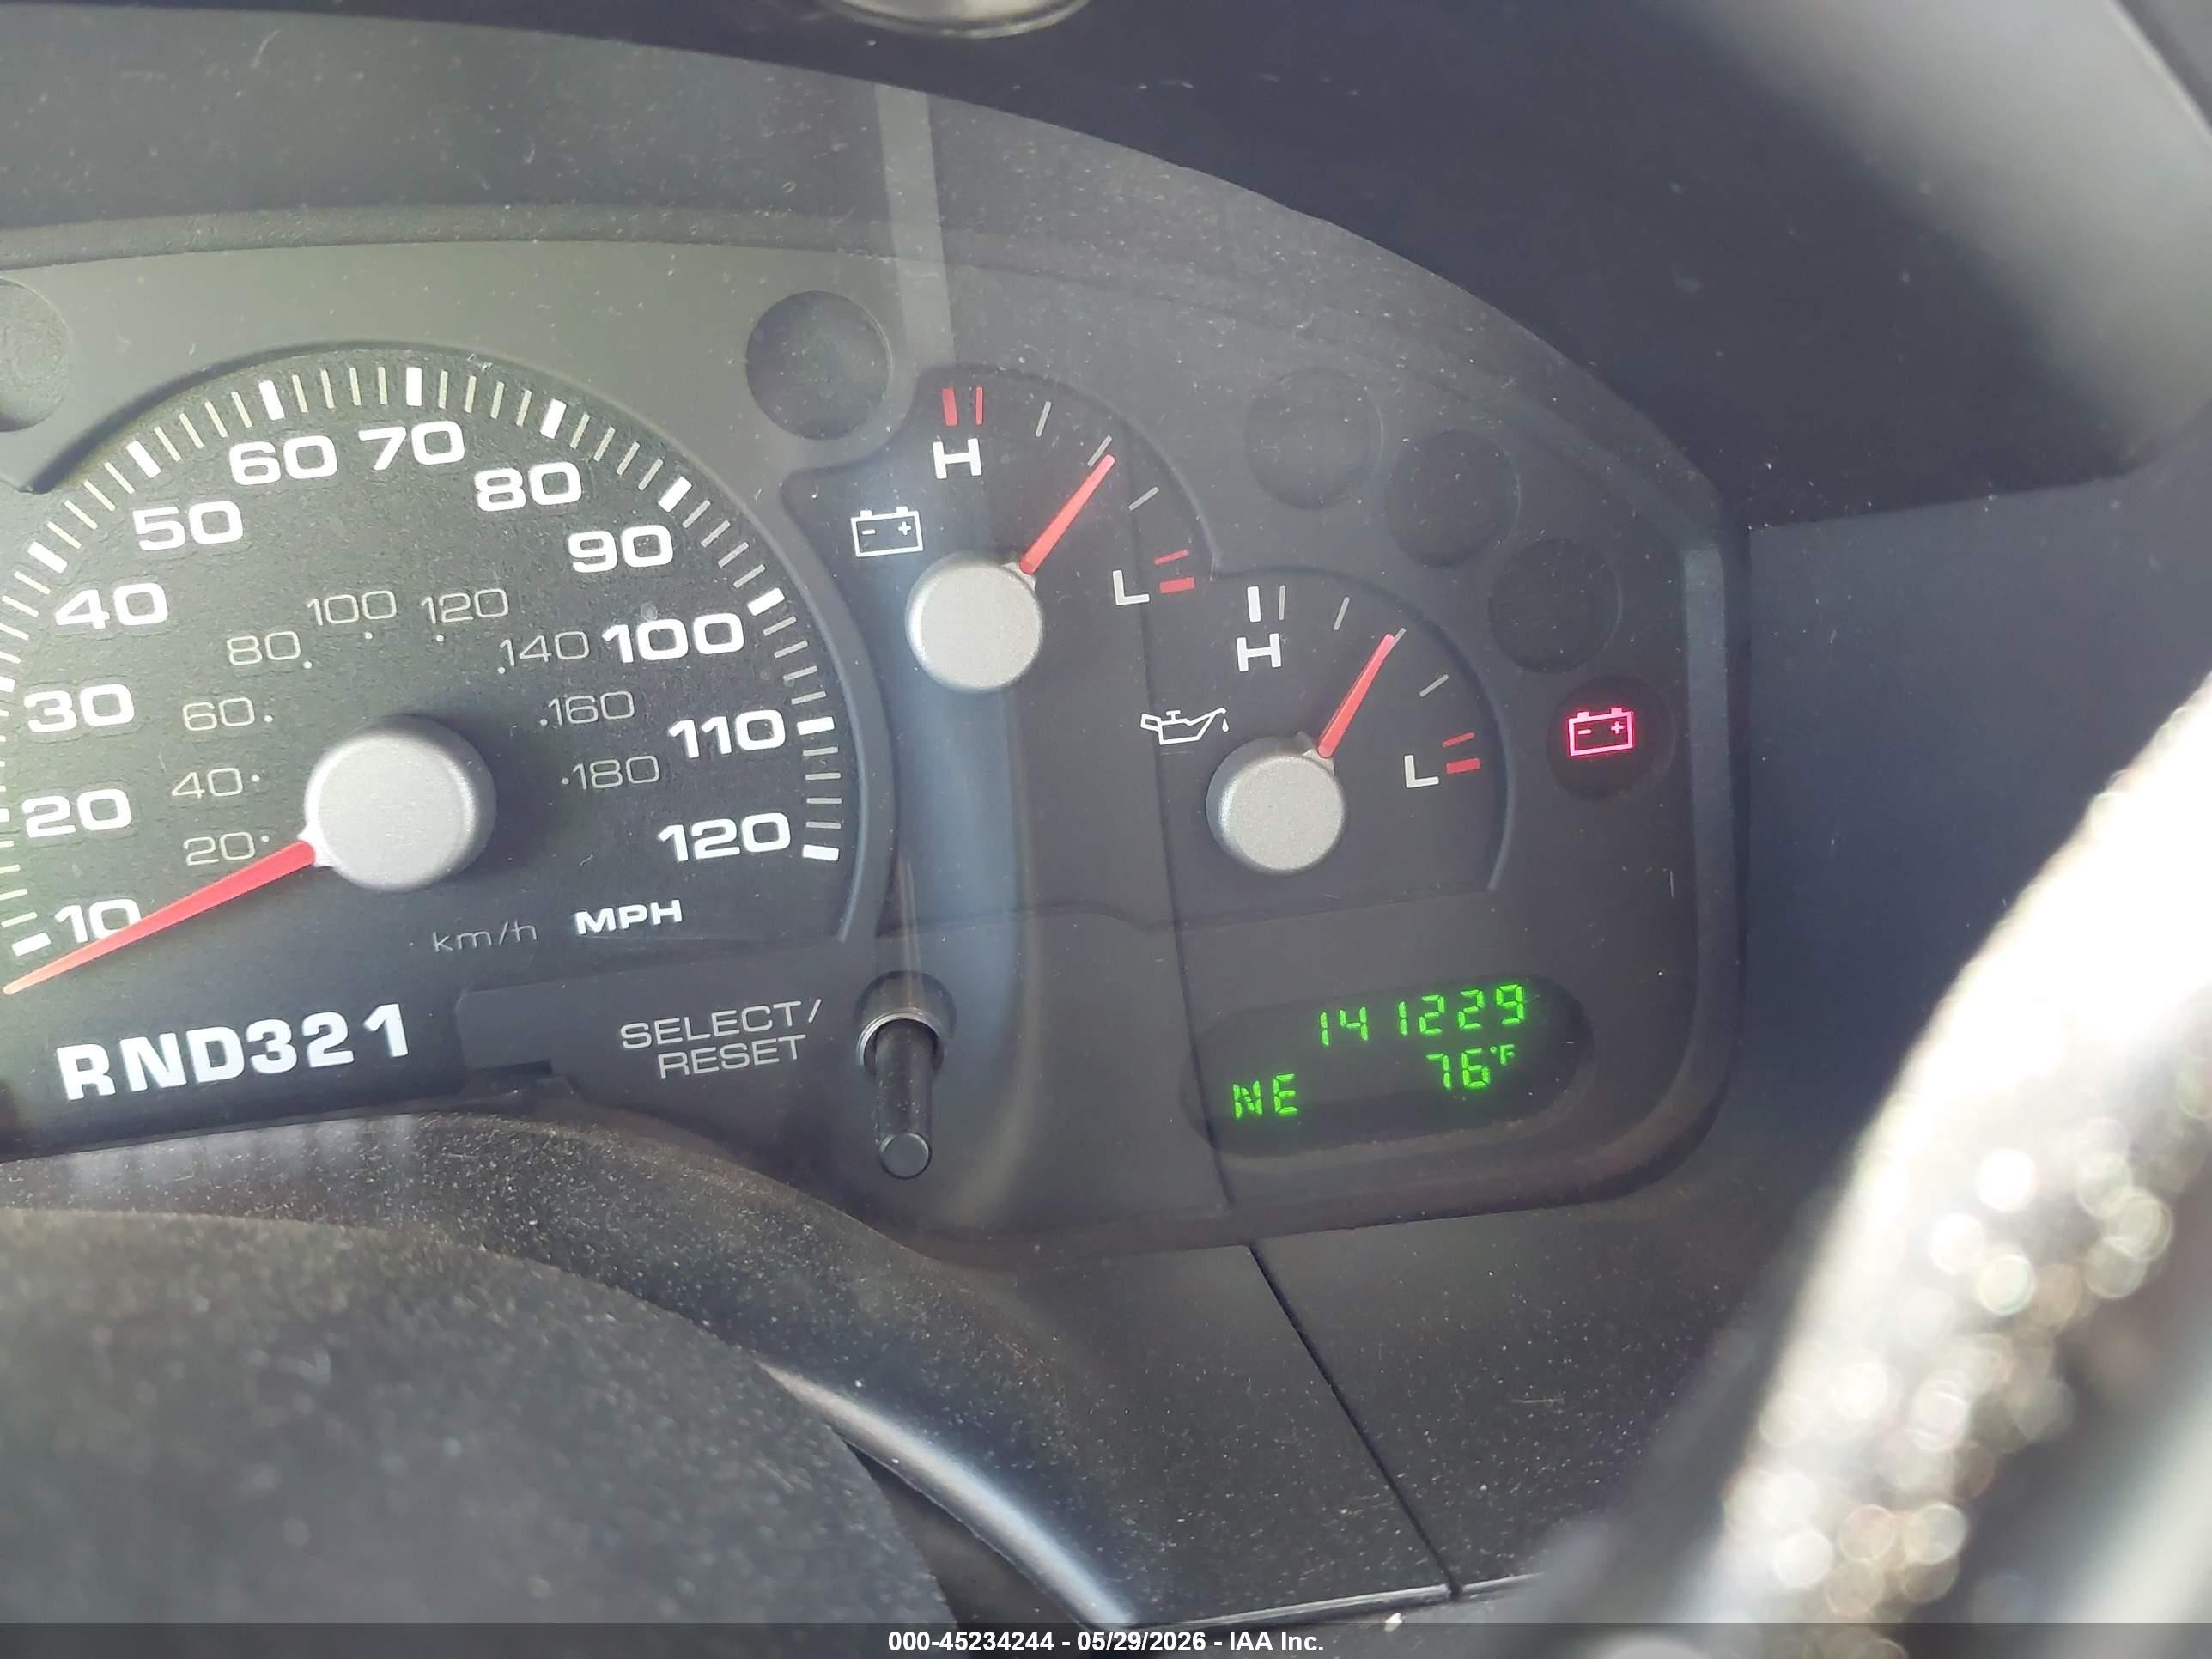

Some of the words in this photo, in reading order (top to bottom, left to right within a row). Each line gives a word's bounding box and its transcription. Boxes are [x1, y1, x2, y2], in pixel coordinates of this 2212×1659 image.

[228, 435, 338, 485] 60
[358, 421, 465, 471] 70
[933, 438, 982, 479] H
[473, 461, 583, 512] 80
[132, 501, 244, 550] 50
[568, 525, 674, 573] 90
[54, 583, 168, 629] 40
[306, 590, 398, 625] 100
[420, 588, 509, 625] 120
[1113, 569, 1150, 605] L
[226, 631, 301, 665] 80
[499, 630, 590, 666] 140
[602, 613, 744, 663] 100
[1236, 632, 1282, 672] H
[23, 684, 135, 733] 30
[182, 697, 255, 731] 60
[548, 690, 635, 726] 160
[668, 709, 786, 758] 110
[172, 767, 244, 799] 40
[573, 755, 660, 790] 180
[1404, 755, 1439, 788] L
[21, 788, 132, 838] 20
[183, 831, 255, 866] 20
[657, 812, 791, 862] 120
[54, 897, 141, 944] 10
[432, 920, 538, 953] km/h
[574, 898, 683, 935] MPH
[620, 999, 823, 1049] SELECT/
[1319, 983, 1526, 1046] 141229
[56, 1002, 409, 1101] RND321
[657, 1033, 806, 1079] RESET
[1232, 1072, 1298, 1119] NE
